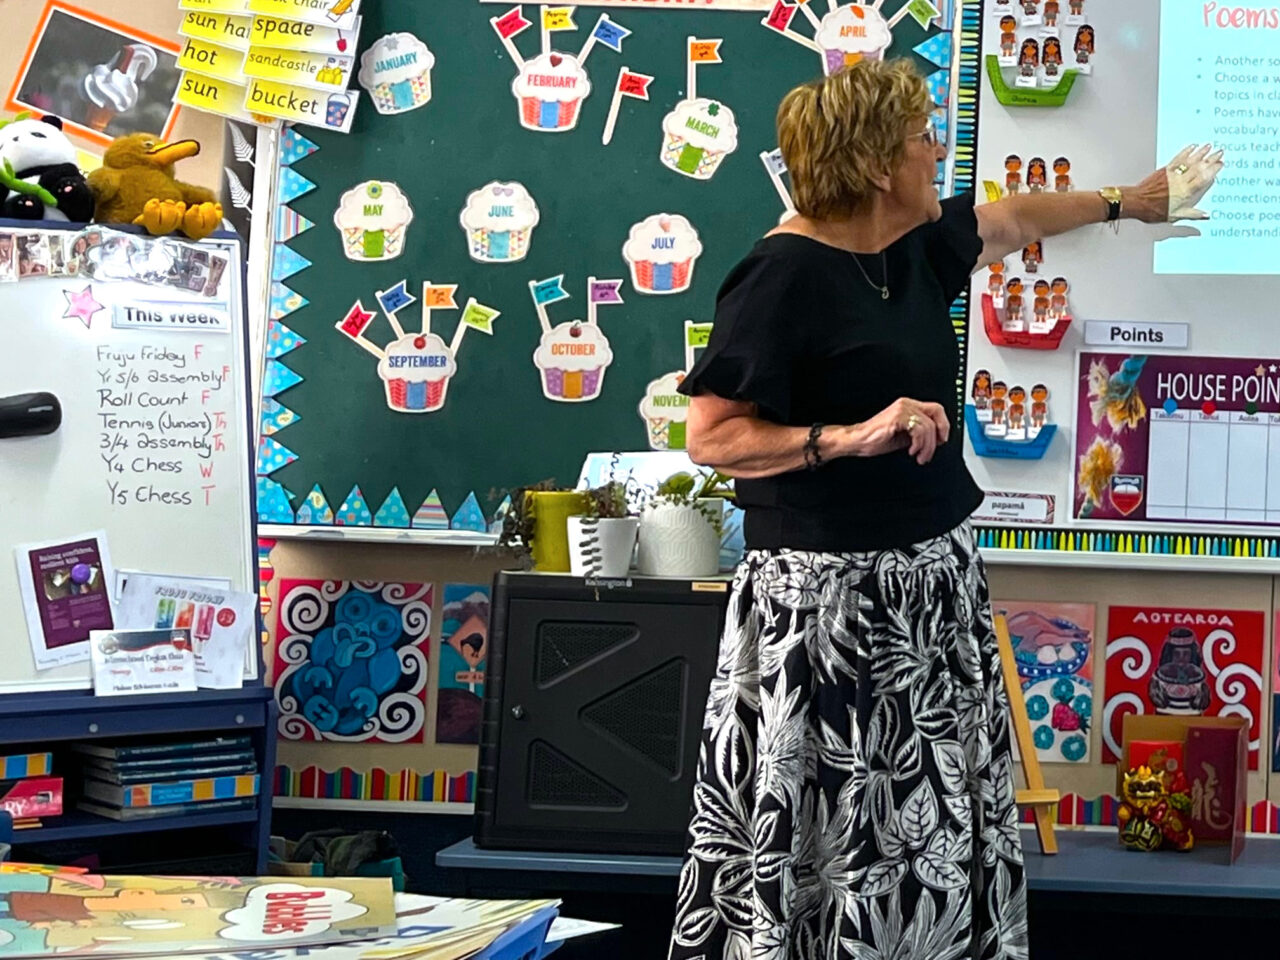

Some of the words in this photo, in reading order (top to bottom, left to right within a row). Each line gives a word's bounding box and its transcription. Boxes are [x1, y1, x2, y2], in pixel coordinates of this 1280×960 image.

[187, 11, 217, 30] sun
[1202, 0, 1280, 29] Poems
[254, 16, 315, 39] spade
[839, 25, 868, 38] APRIL
[182, 38, 218, 66] hot
[1214, 55, 1265, 67] Another
[249, 51, 317, 74] sandcastle
[374, 51, 418, 74] JANUARY
[526, 73, 579, 89] FEBRUARY
[1214, 71, 1259, 84] Choose
[182, 78, 219, 101] sun
[251, 82, 319, 115] bucket
[1213, 89, 1251, 103] topics
[1253, 90, 1265, 101] in
[1213, 106, 1255, 118] Poems
[684, 115, 721, 139] MARCH
[1213, 123, 1279, 138] vocabulary
[1252, 158, 1275, 169] and
[363, 204, 384, 216] MAY
[488, 204, 515, 218] JUNE
[1211, 209, 1256, 222] Choose
[651, 237, 676, 250] JULY
[123, 306, 163, 323] This
[1109, 325, 1165, 344] Points
[96, 344, 136, 368] Fruju
[140, 344, 186, 368] Friday
[194, 344, 204, 360] F
[551, 343, 596, 357] OCTOBER
[388, 355, 447, 369] SEPTEMBER
[97, 368, 112, 384] Yr
[115, 368, 140, 390] 5/6
[147, 369, 222, 391] assembly
[222, 365, 231, 382] F
[1156, 371, 1227, 403] HOUSE
[96, 388, 133, 408] Roll
[137, 391, 189, 408] Count
[201, 389, 211, 406] F
[97, 412, 155, 430] Tennis
[158, 410, 212, 437] (Junior)
[212, 411, 227, 429] Th
[99, 432, 129, 453] 3/4
[137, 432, 212, 459] assembly
[212, 432, 226, 452] Th
[101, 453, 125, 474] Y4
[131, 457, 183, 473] Chess
[199, 461, 214, 478] W
[106, 480, 129, 505] Y5
[135, 484, 192, 506] Chess
[201, 484, 217, 507] T
[1133, 611, 1234, 627] AOTEAROA
